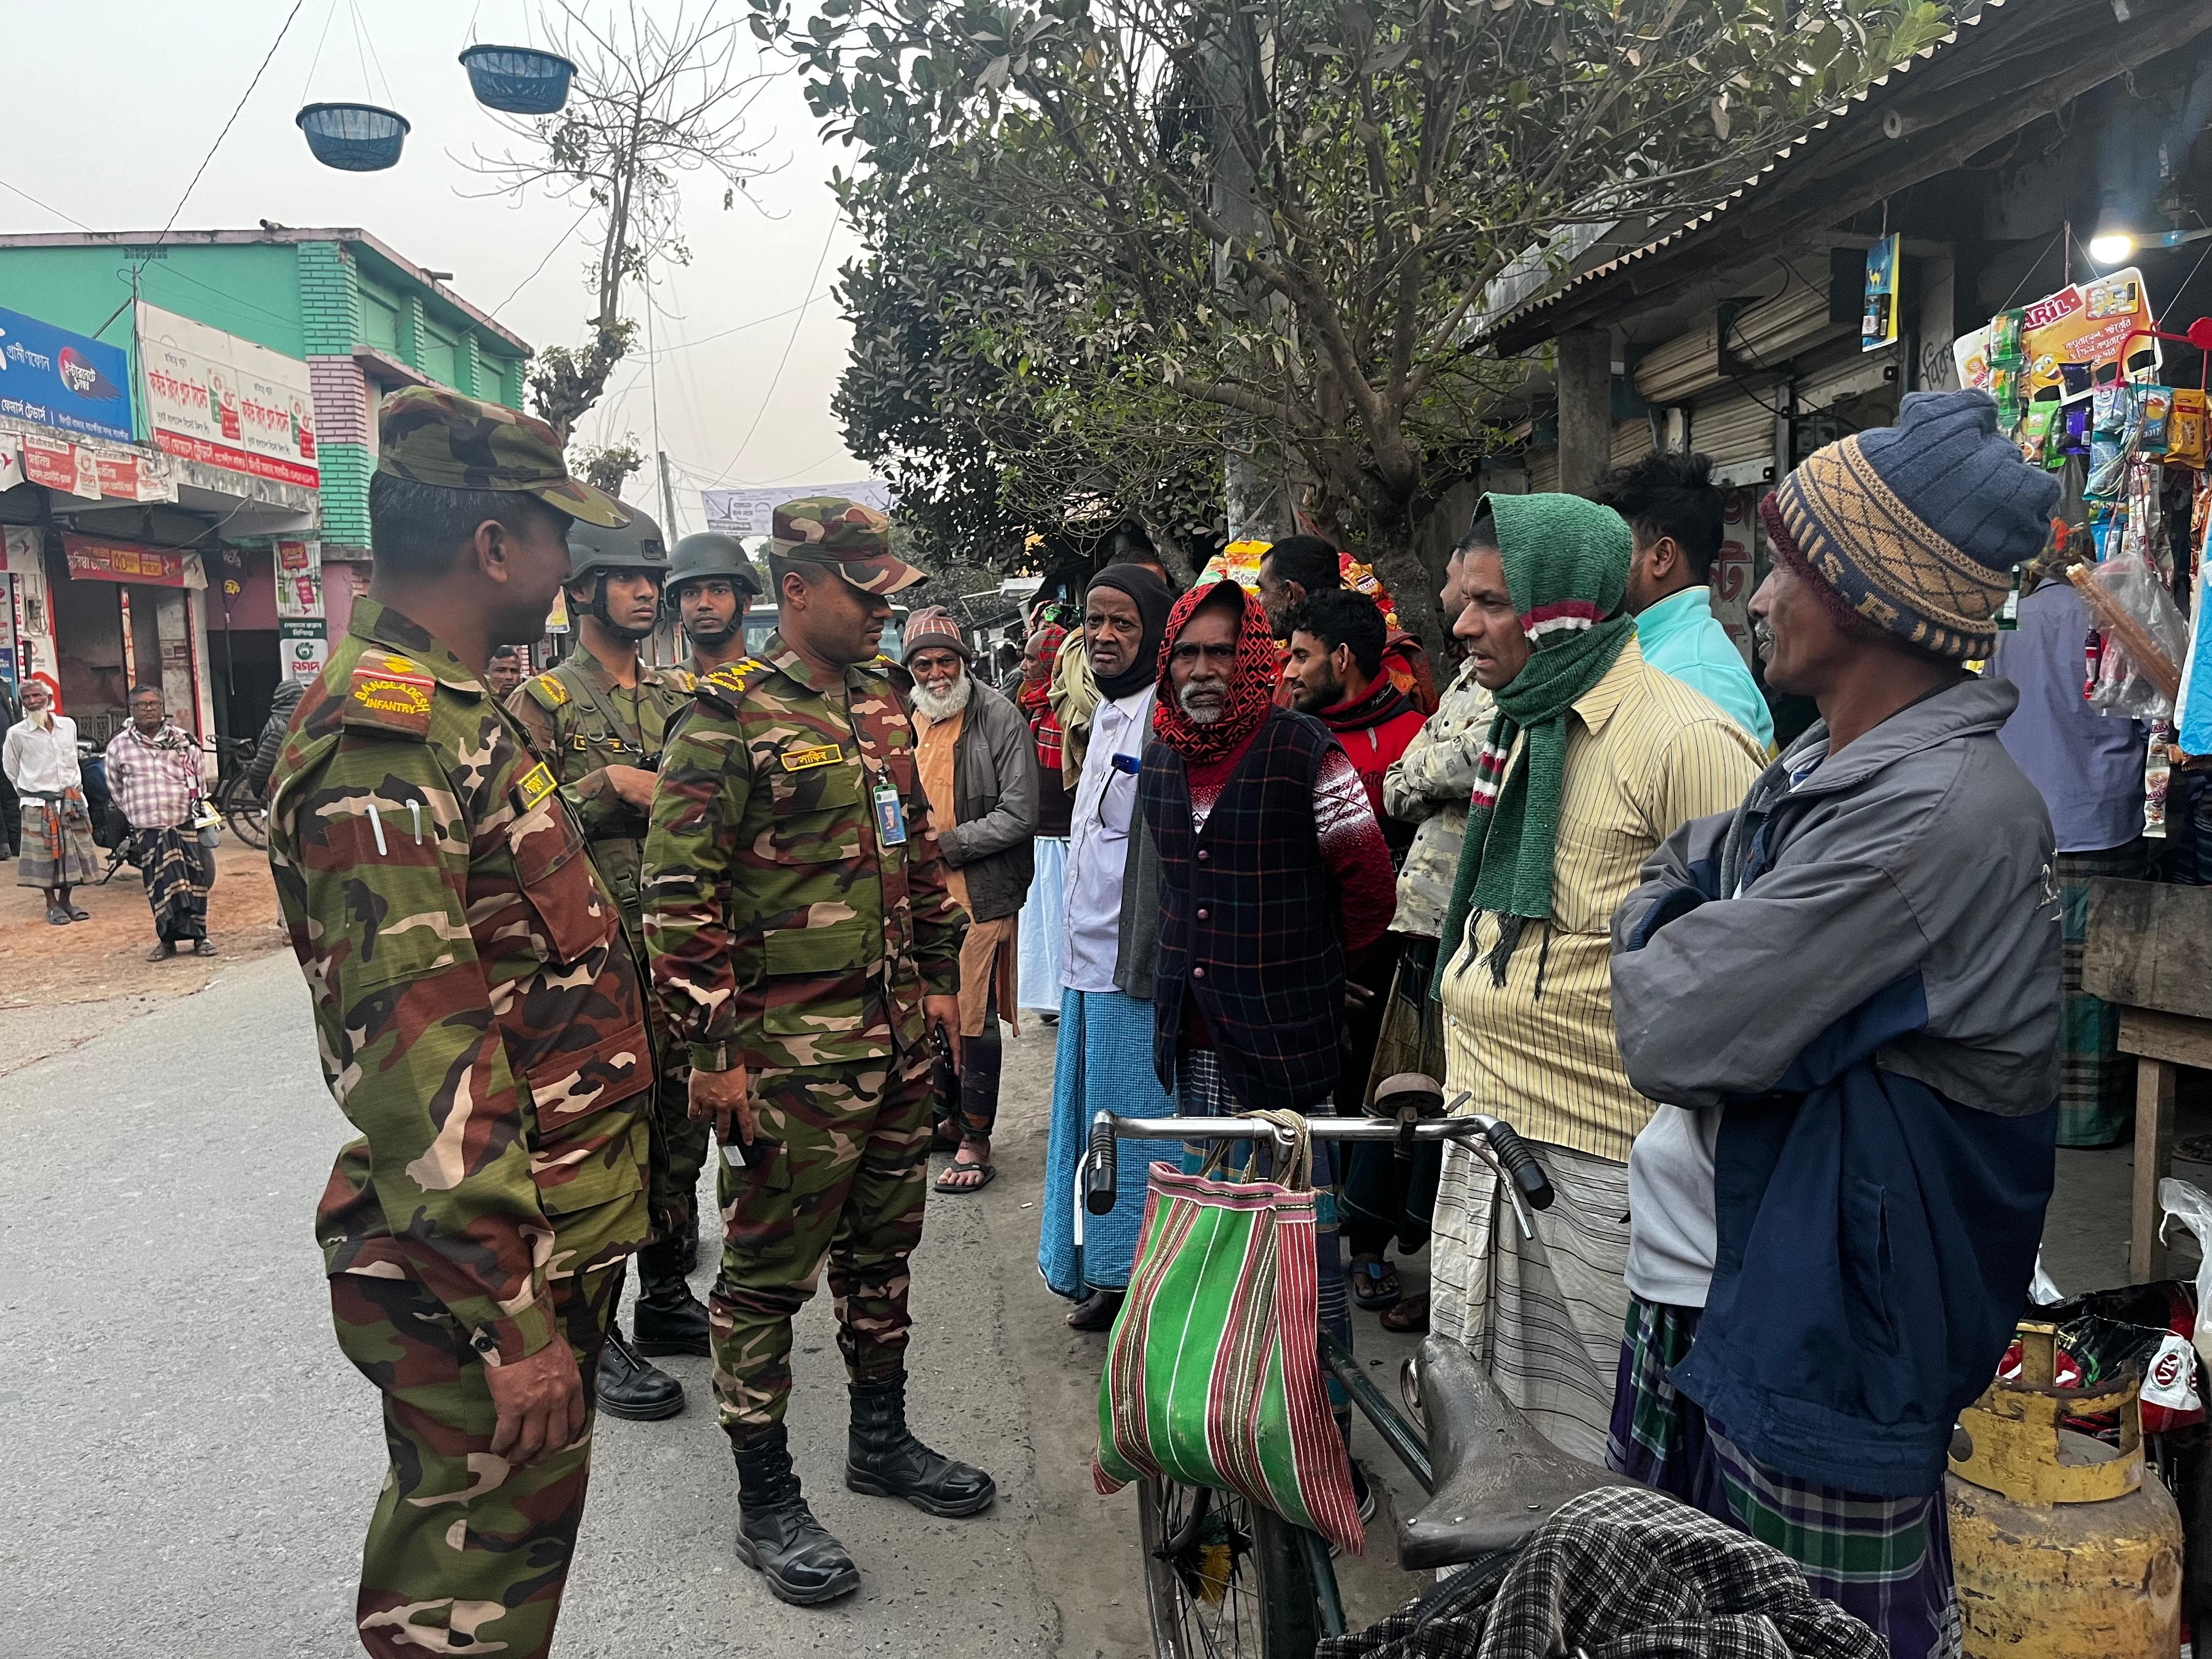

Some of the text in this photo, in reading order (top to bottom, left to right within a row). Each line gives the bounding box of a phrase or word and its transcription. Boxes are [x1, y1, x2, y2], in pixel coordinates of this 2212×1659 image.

[7, 342, 50, 372] গ্রামীণফোন
[64, 359, 95, 382] ইন্টারনেটে
[354, 681, 430, 712] BANGLADESH
[363, 698, 416, 714] INFANTRY
[798, 751, 827, 764] সাকিব
[2158, 1358, 2180, 1380] VK
